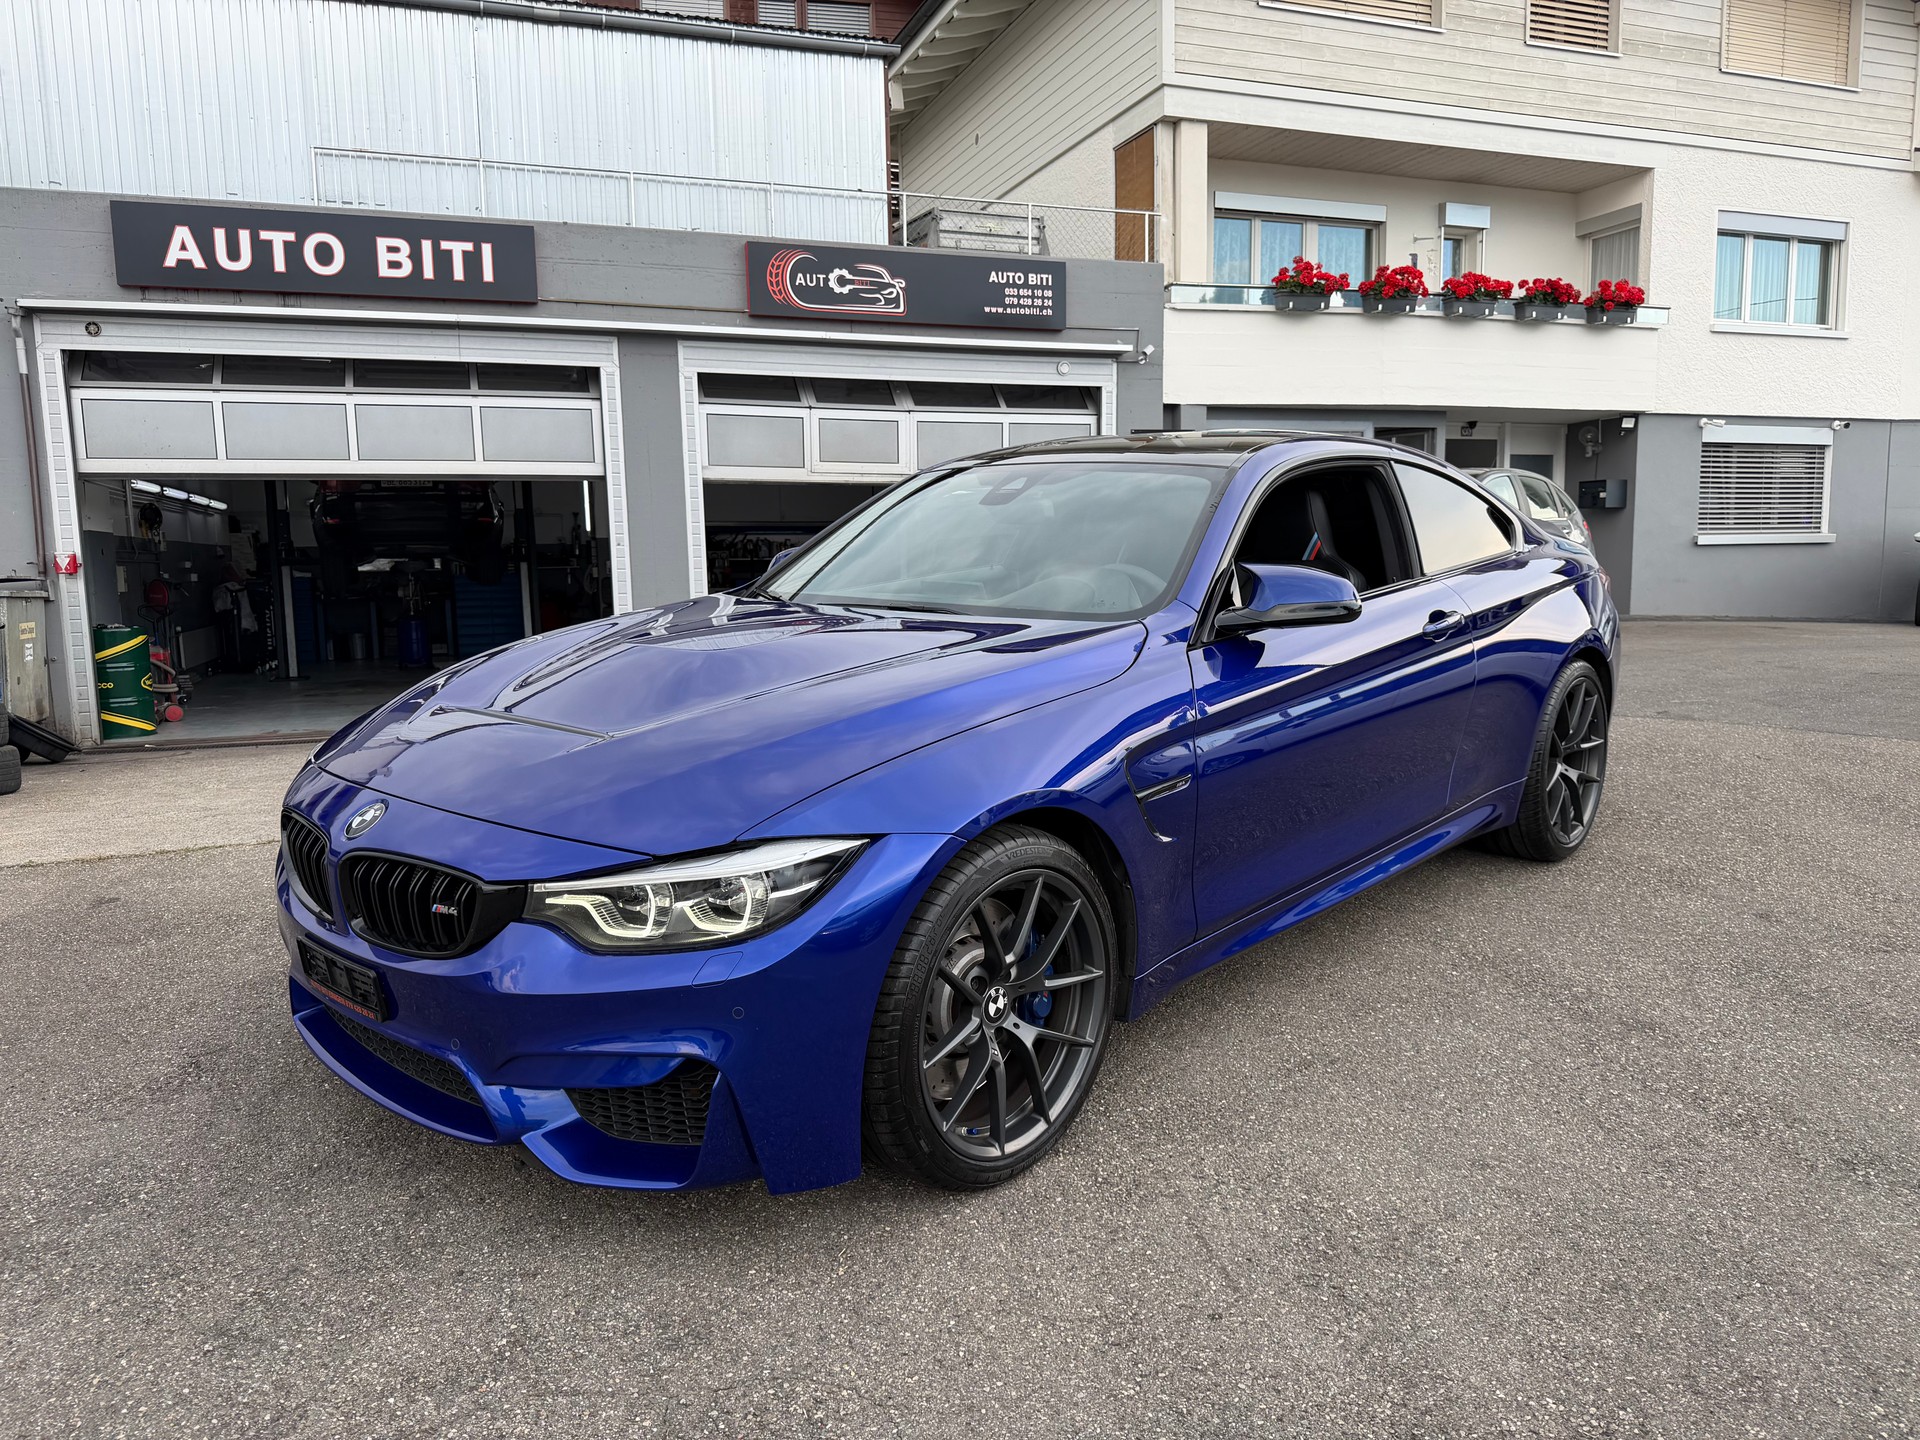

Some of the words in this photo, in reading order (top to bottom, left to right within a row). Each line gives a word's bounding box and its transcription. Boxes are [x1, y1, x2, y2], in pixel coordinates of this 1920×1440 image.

[162, 225, 346, 276] AUTO
[375, 236, 495, 283] BITI
[988, 270, 1025, 285] AUTO
[1028, 273, 1053, 286] BITI
[1004, 287, 1018, 296] 033
[1019, 288, 1032, 296] 654
[1033, 289, 1042, 297] 10
[1004, 297, 1018, 305] 079
[1019, 297, 1032, 306] 428
[1043, 299, 1053, 307] 24
[983, 306, 1053, 316] www.autobiti.ch
